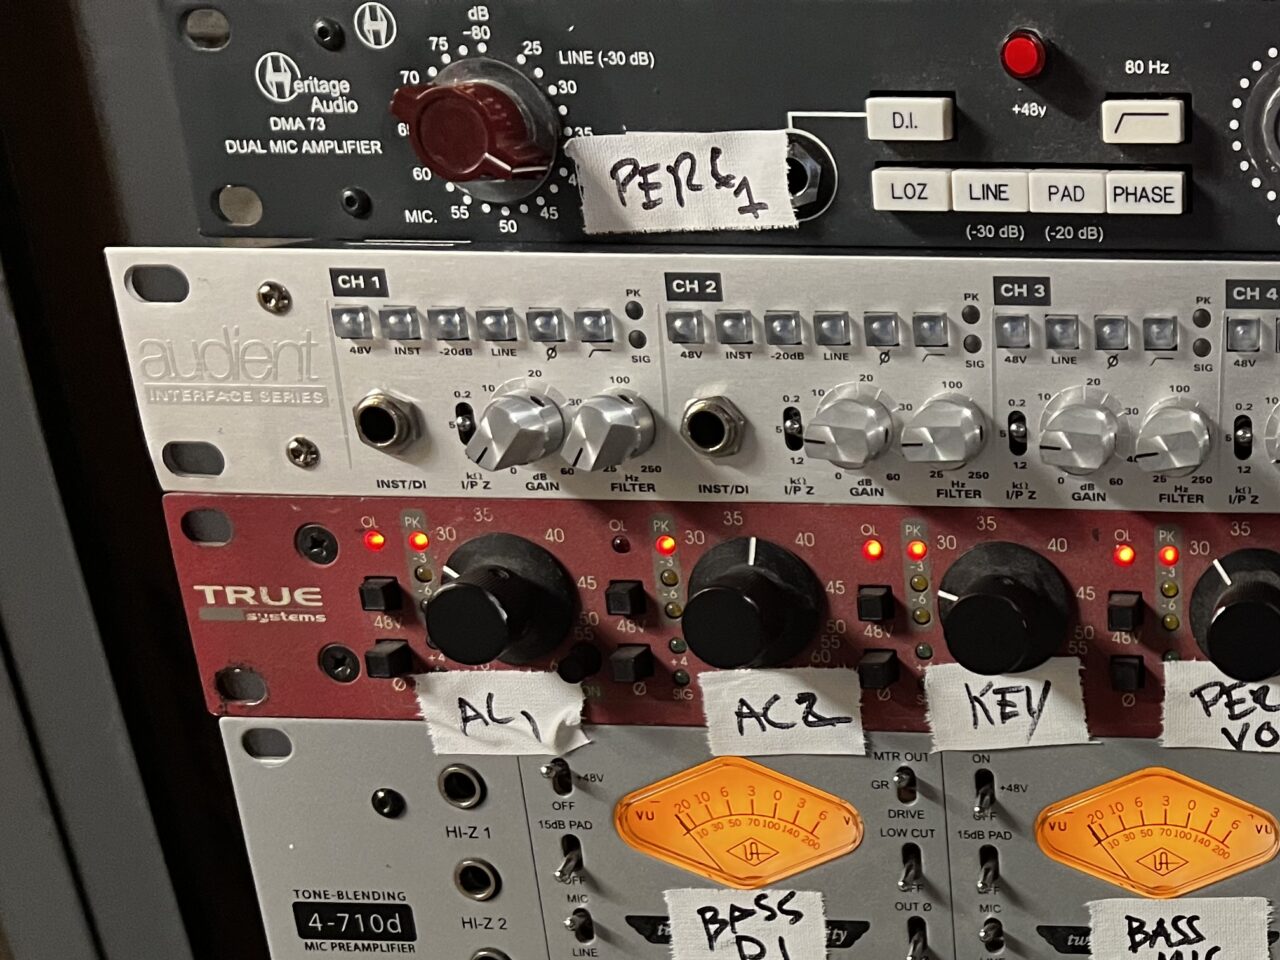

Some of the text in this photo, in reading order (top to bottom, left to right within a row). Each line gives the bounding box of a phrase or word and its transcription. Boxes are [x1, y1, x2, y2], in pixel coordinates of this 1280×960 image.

[559, 50, 655, 68] LINE (-30 dB)
[1125, 60, 1170, 75] 80 Hz
[311, 97, 358, 113] Audio
[270, 117, 326, 131] DMA 73
[892, 112, 918, 129] D.I.
[225, 140, 382, 155] DUAL MIC AMPLIFIER
[891, 183, 928, 200] LOZ
[969, 184, 1010, 201] LINE
[1048, 185, 1084, 202] PAD
[1113, 186, 1175, 204] PHASE
[338, 276, 380, 289] CH 1
[672, 280, 717, 293] CH 2
[1001, 284, 1045, 297] CH 3
[1233, 288, 1278, 300] CH 4
[139, 325, 319, 381] audient
[149, 390, 324, 404] INTERFACE SERIES
[377, 479, 426, 489] INST/DI
[526, 482, 560, 491] GAIN
[611, 483, 655, 492] FILTER
[698, 485, 748, 495] INST/DI
[193, 585, 323, 606] TRUE
[246, 611, 326, 623] systems
[965, 681, 1051, 743] KEY
[446, 826, 491, 839] HI-Z 1
[293, 889, 406, 901] TONE-BLENDING
[308, 913, 402, 934] 4-710d
[462, 917, 507, 930] HI-Z 2
[1126, 916, 1206, 952] BASS
[304, 942, 415, 953] MIC PREAMPLIFIER
